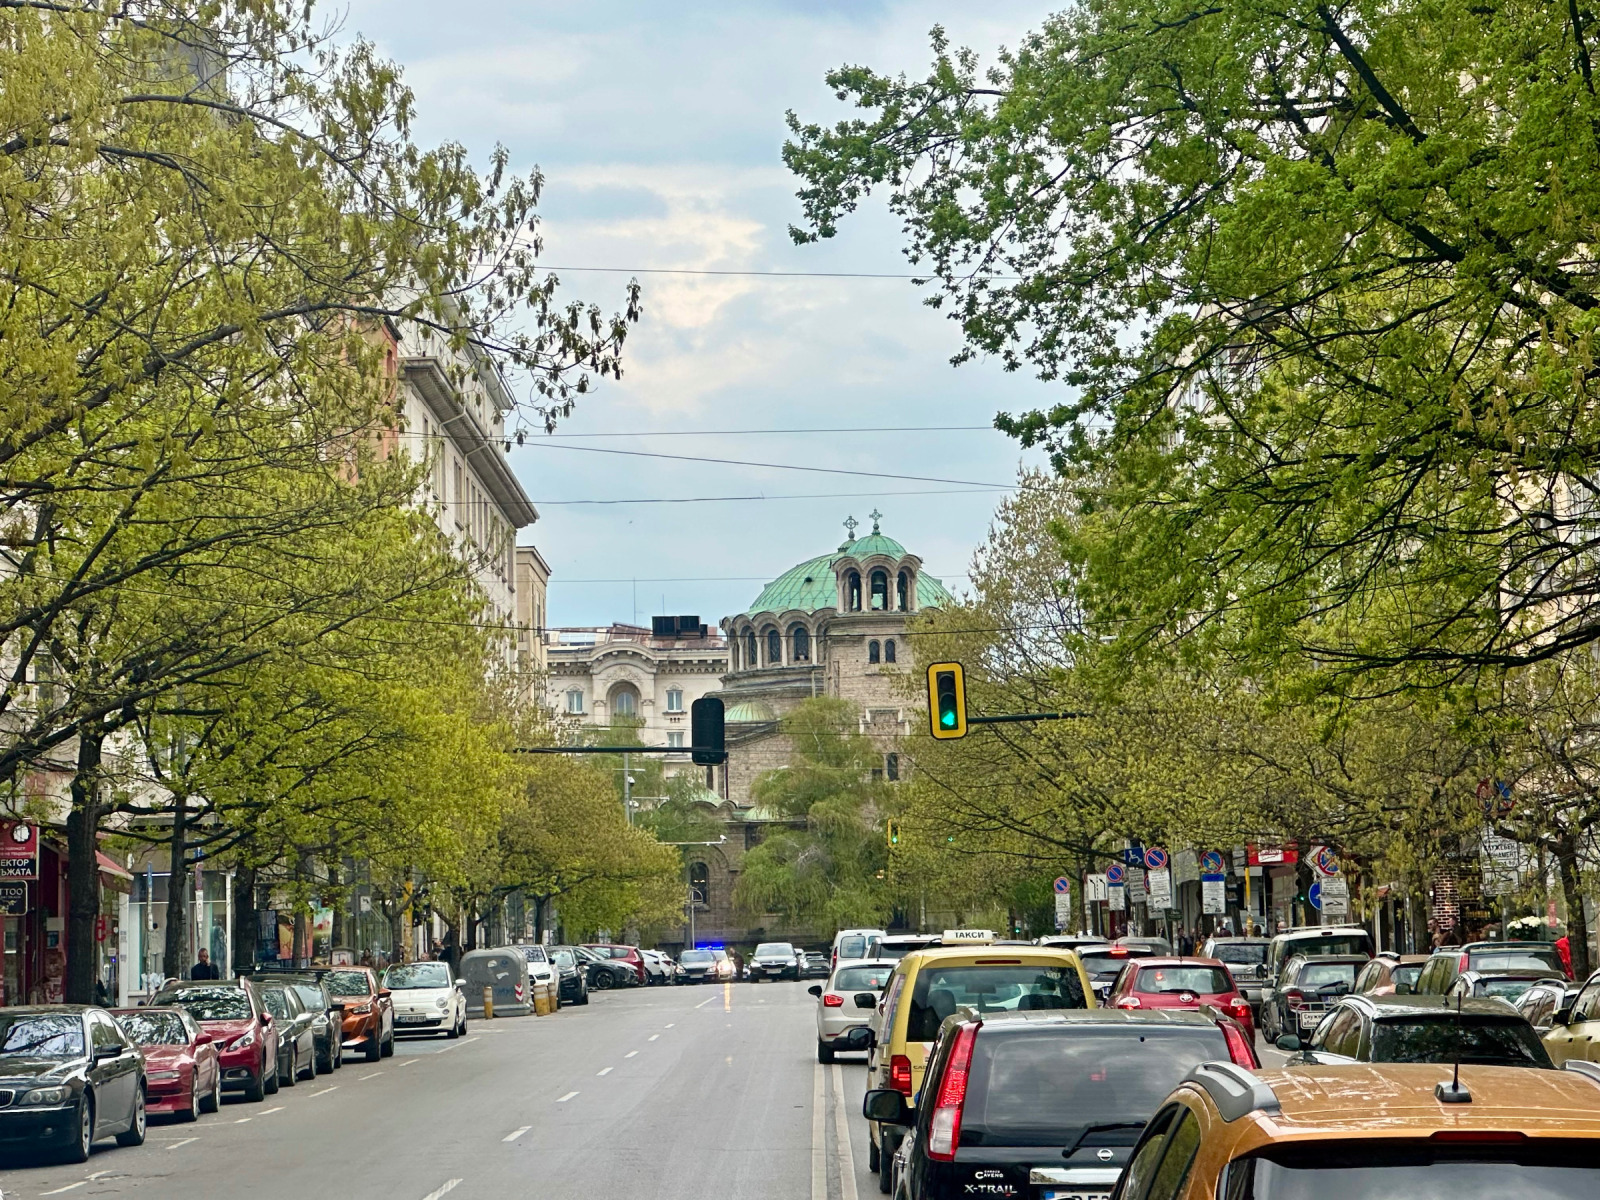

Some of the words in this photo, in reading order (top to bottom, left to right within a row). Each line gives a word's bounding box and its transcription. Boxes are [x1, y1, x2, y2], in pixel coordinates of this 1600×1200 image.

[0, 859, 30, 867] ЕКТОР
[955, 931, 985, 939] ТАКСИ
[964, 1184, 1018, 1194] X-TRAIL
